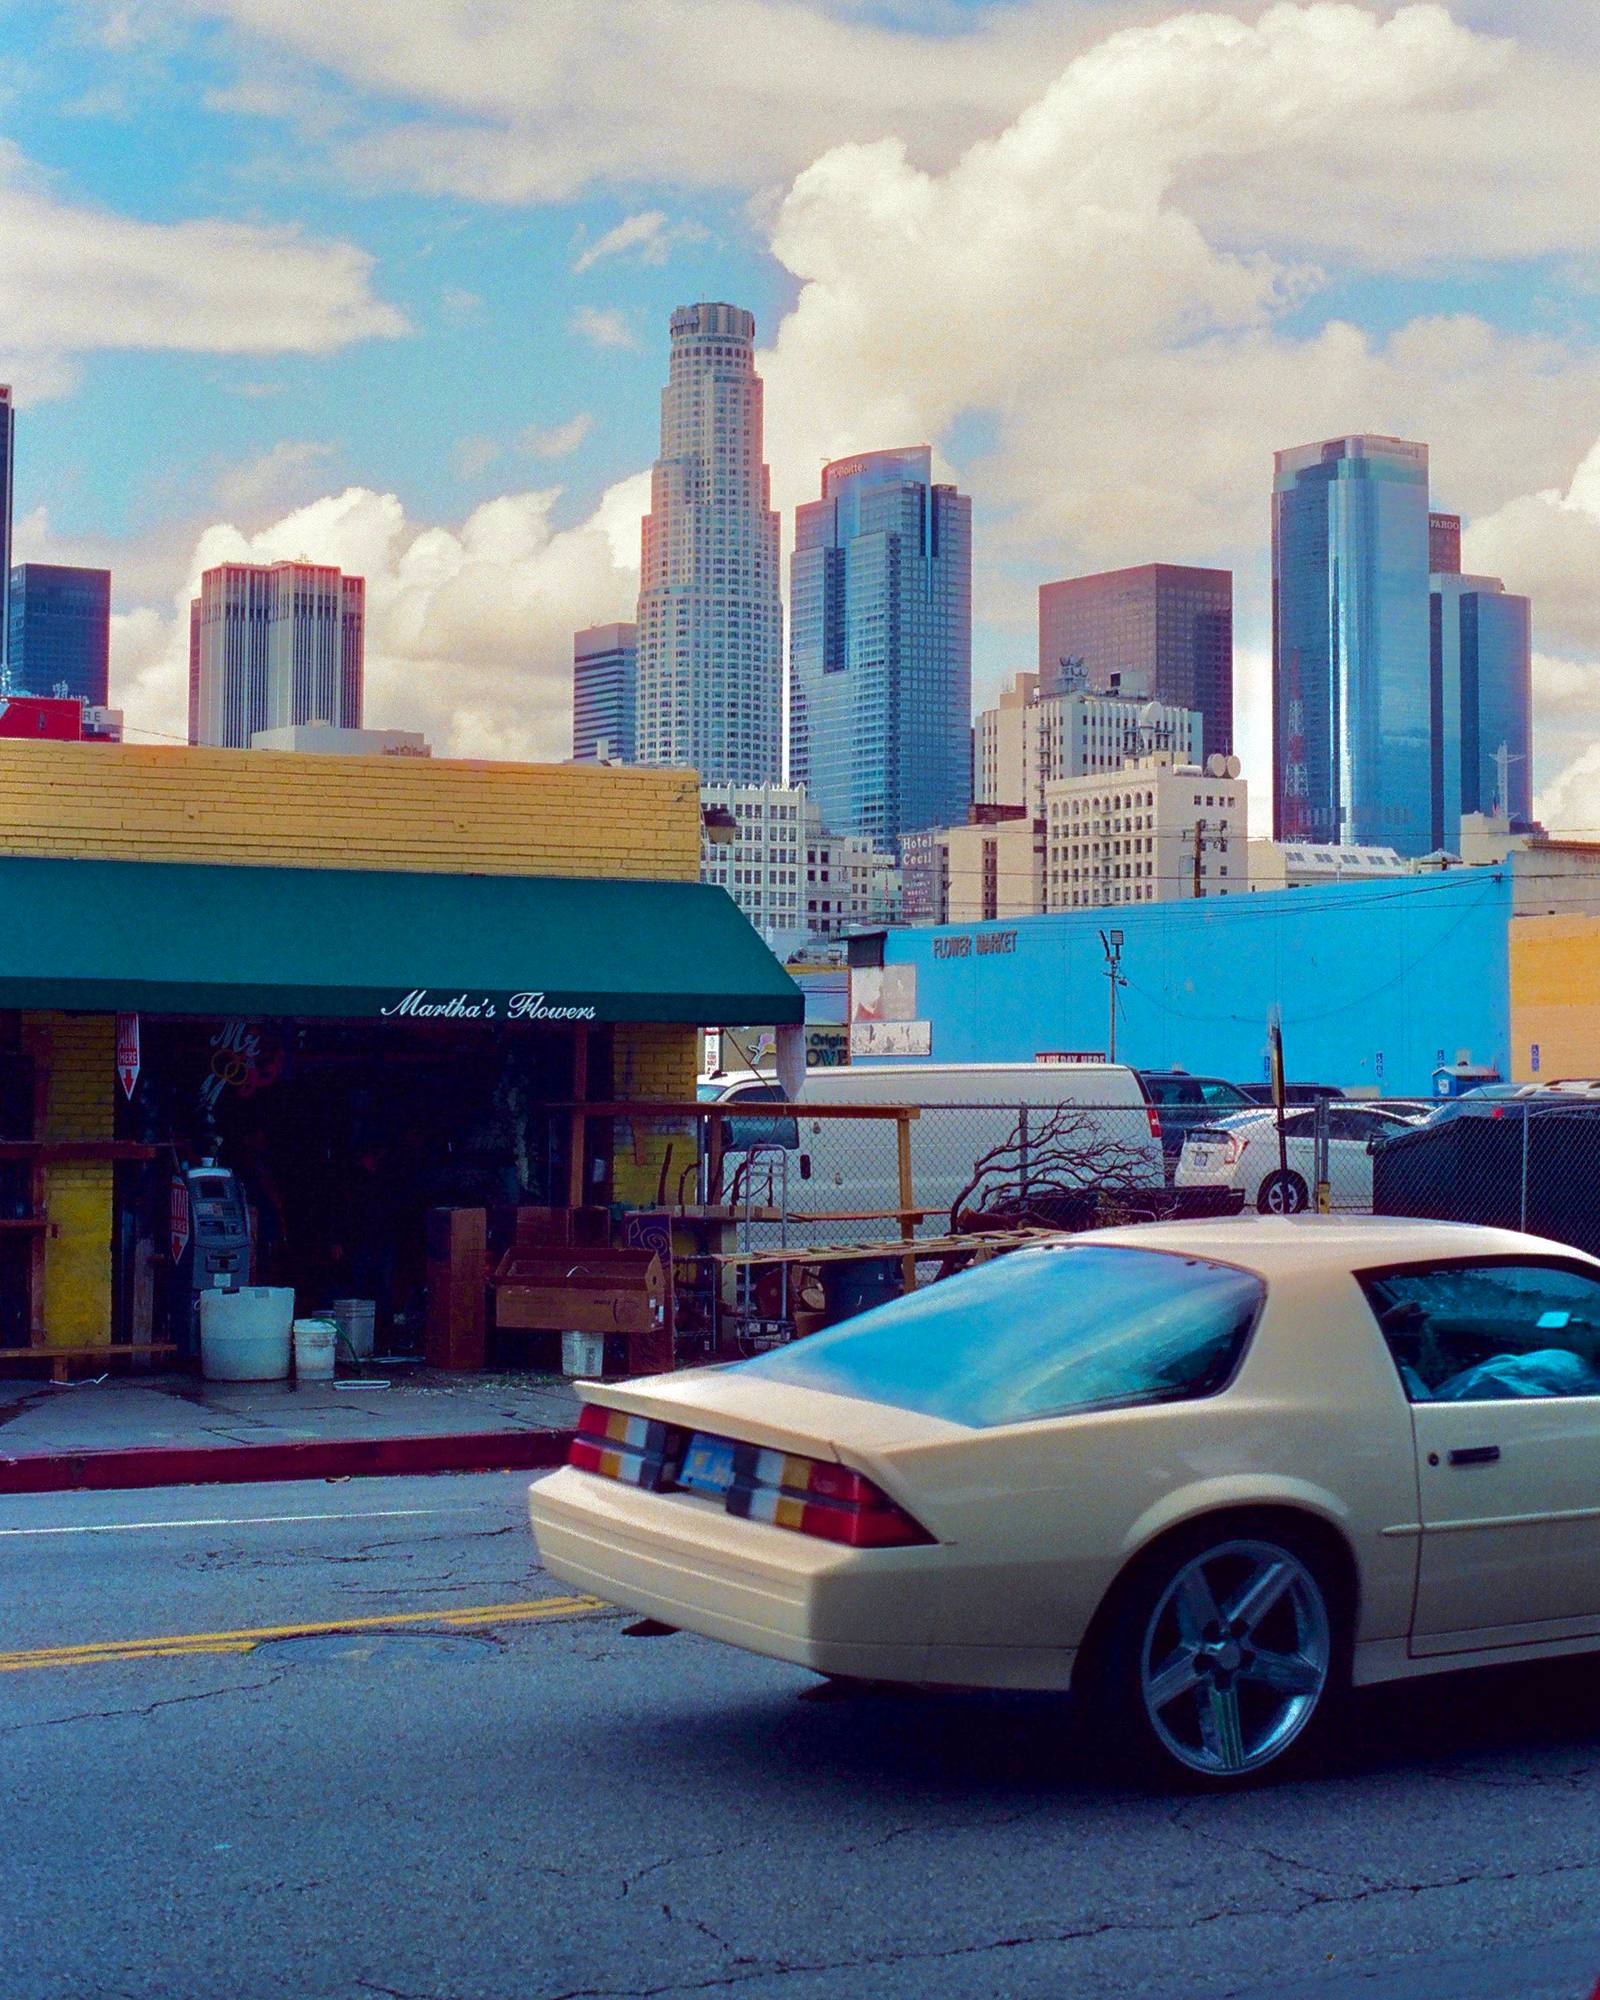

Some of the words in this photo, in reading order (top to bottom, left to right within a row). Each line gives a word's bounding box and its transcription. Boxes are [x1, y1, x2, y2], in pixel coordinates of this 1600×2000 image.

[1430, 519, 1459, 530] FARGO
[903, 836, 932, 850] Hotel
[903, 852, 932, 865] Cecil
[933, 936, 972, 959] FLOWER
[976, 929, 1017, 955] MARKET
[380, 989, 497, 1018] Martha's
[507, 991, 596, 1020] Flowers
